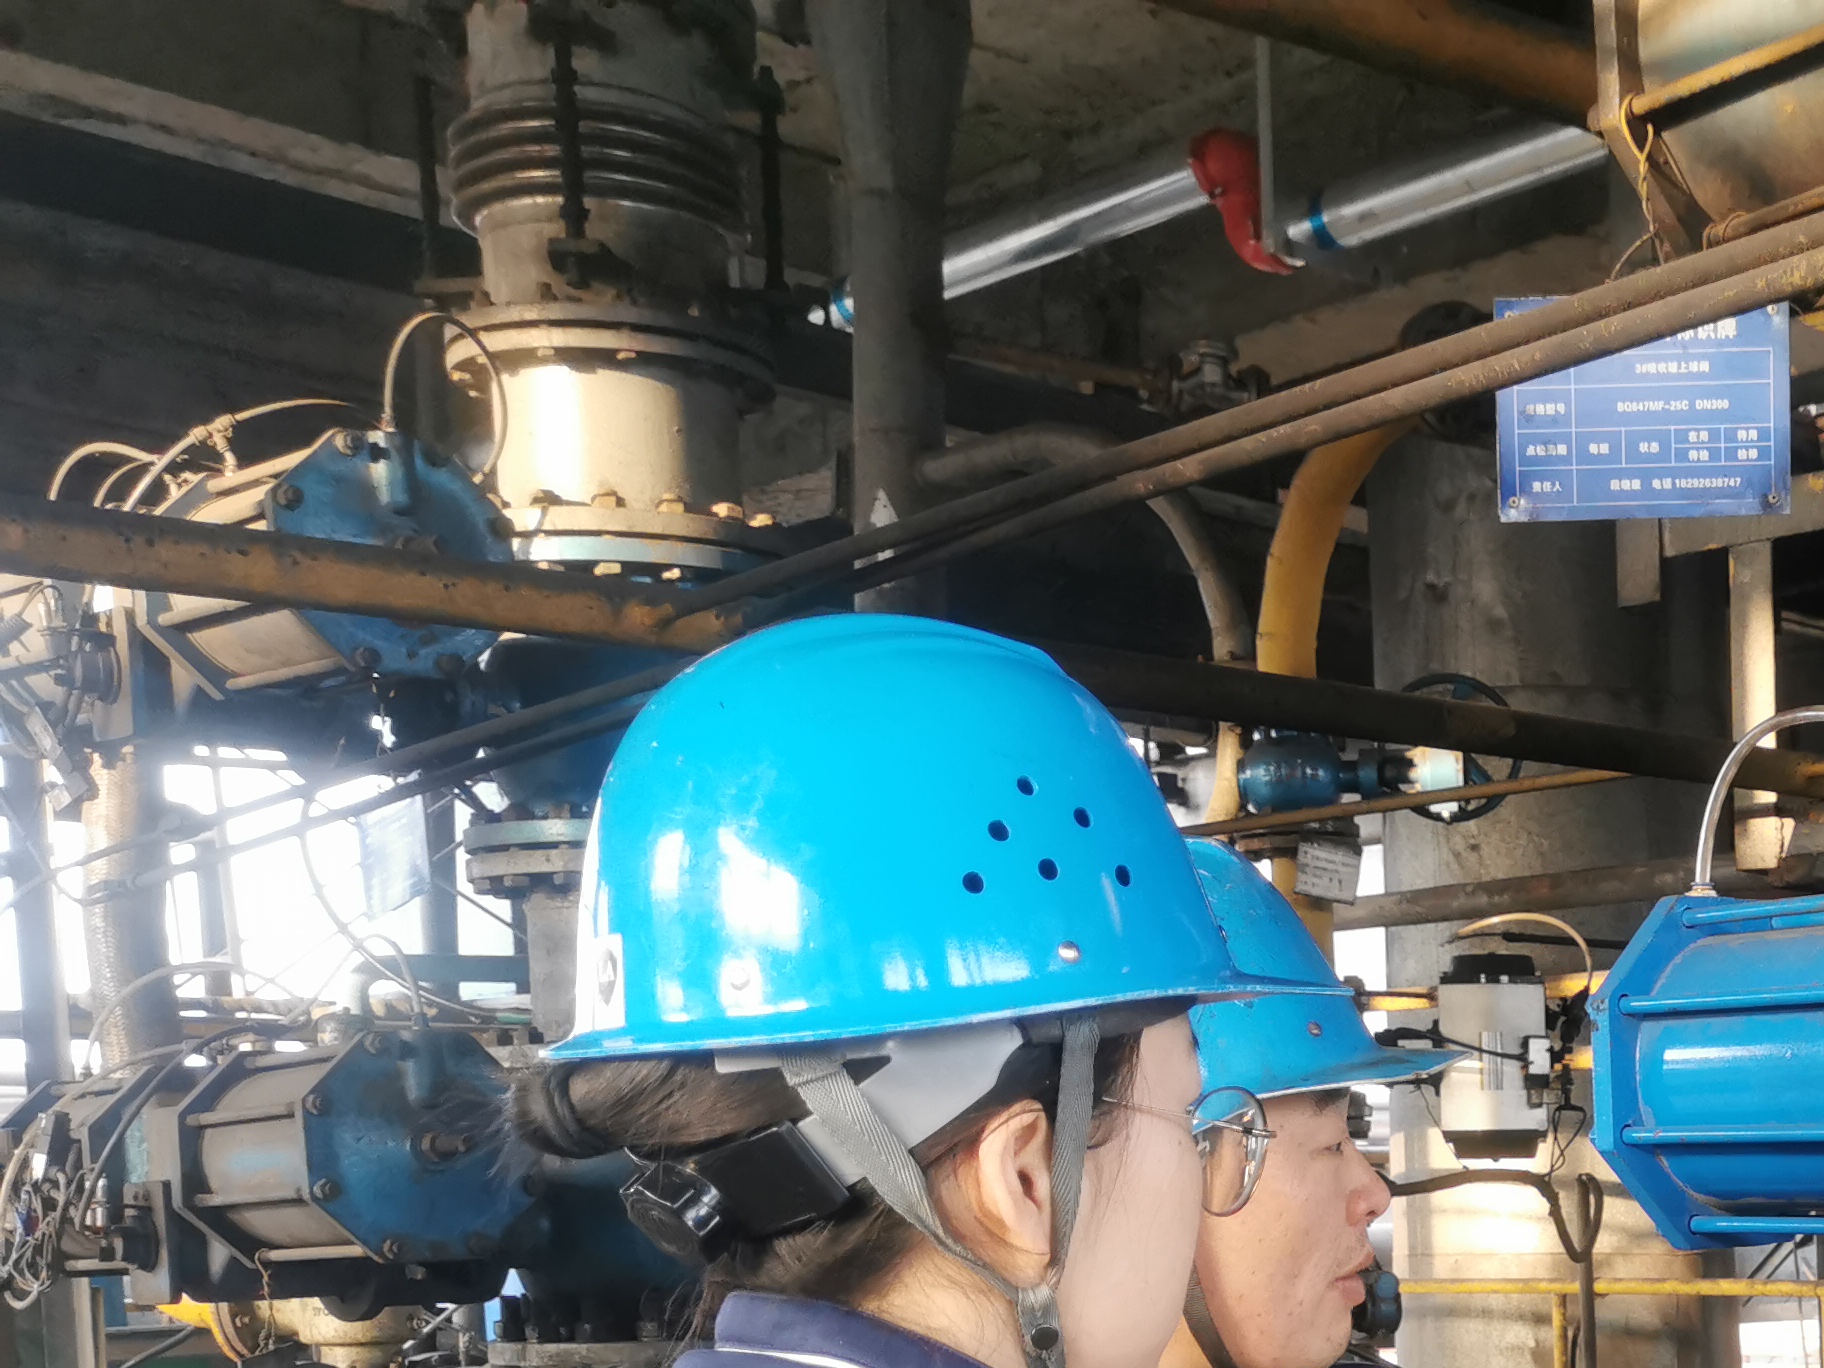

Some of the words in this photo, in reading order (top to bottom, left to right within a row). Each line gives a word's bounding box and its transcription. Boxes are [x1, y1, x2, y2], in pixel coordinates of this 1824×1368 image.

[1695, 399, 1729, 410] DN300
[1532, 481, 1562, 492] 责任人
